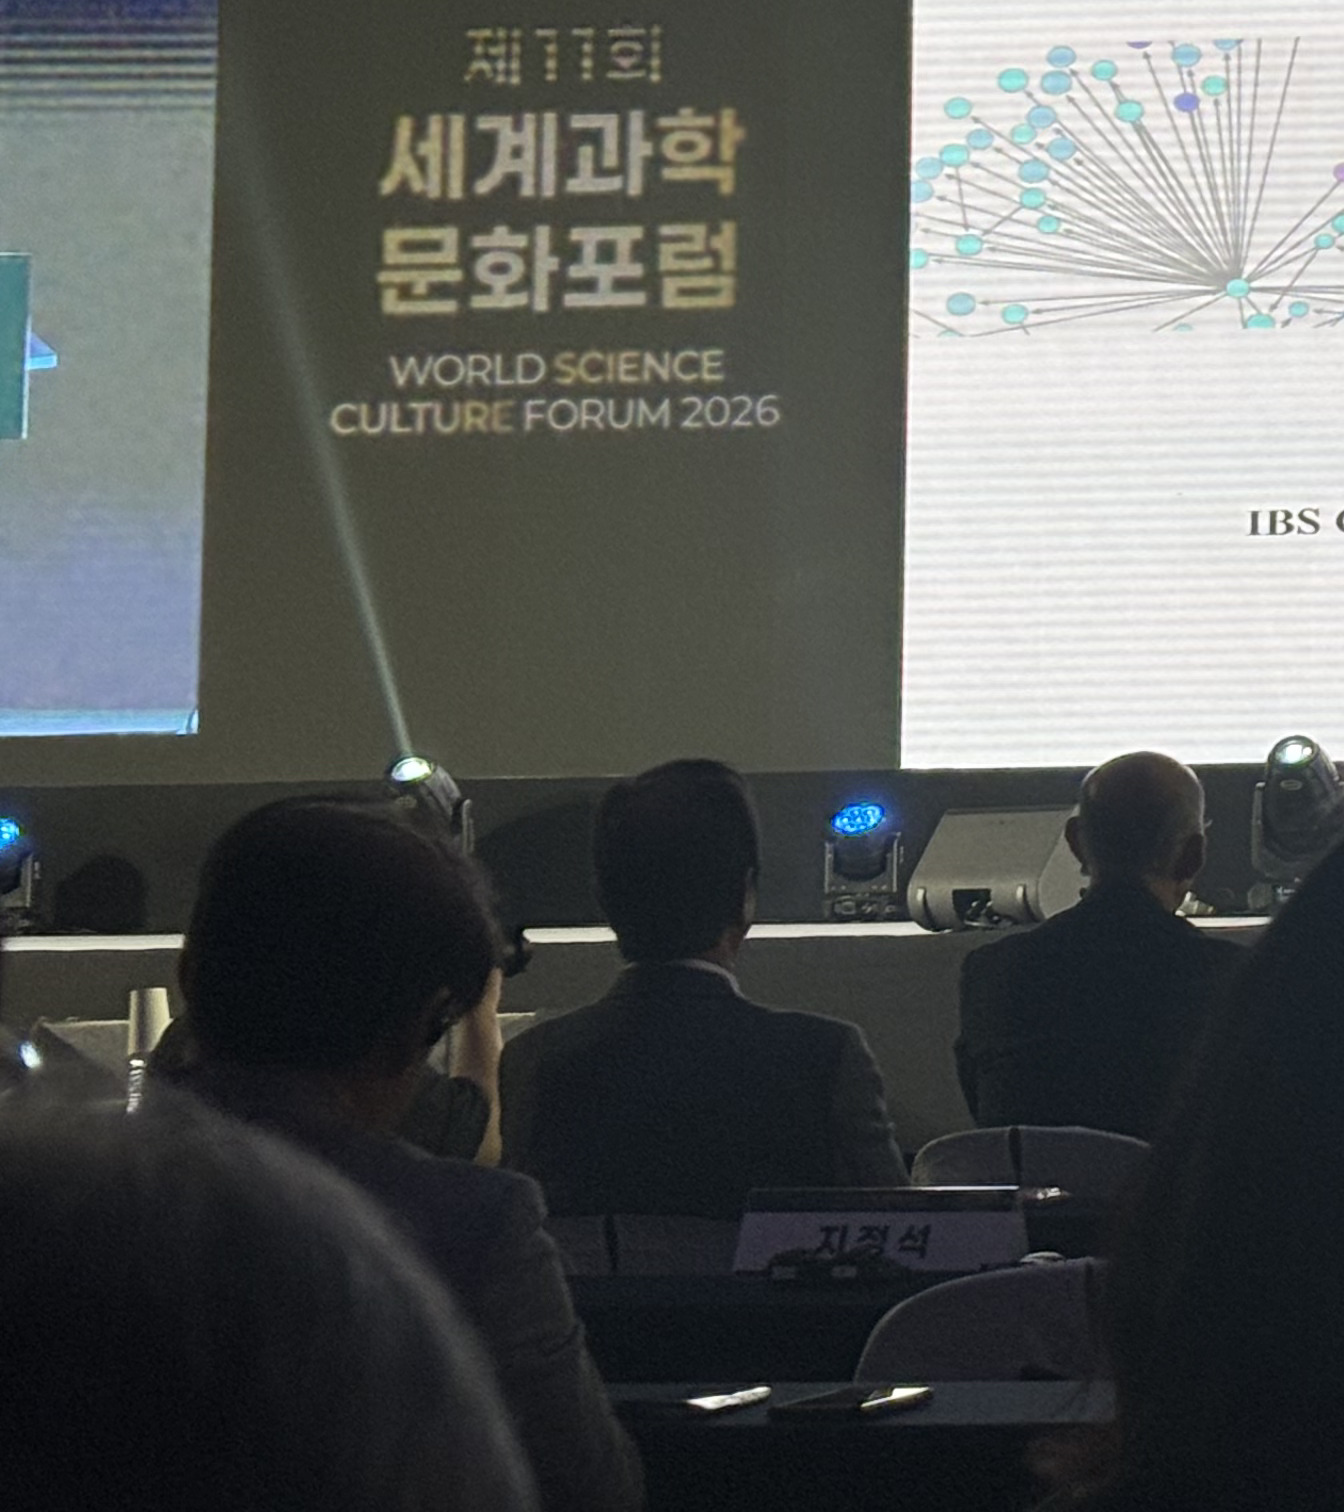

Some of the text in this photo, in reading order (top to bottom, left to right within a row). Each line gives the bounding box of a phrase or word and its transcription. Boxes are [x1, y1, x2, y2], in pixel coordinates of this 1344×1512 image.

[463, 25, 662, 86] 제11회
[378, 106, 747, 202] 세계과학
[375, 220, 738, 317] 문화포럼
[388, 347, 726, 389] WORLD SCIENCE
[329, 393, 783, 436] CULTURE FORUM 2026
[1249, 508, 1320, 536] IBS
